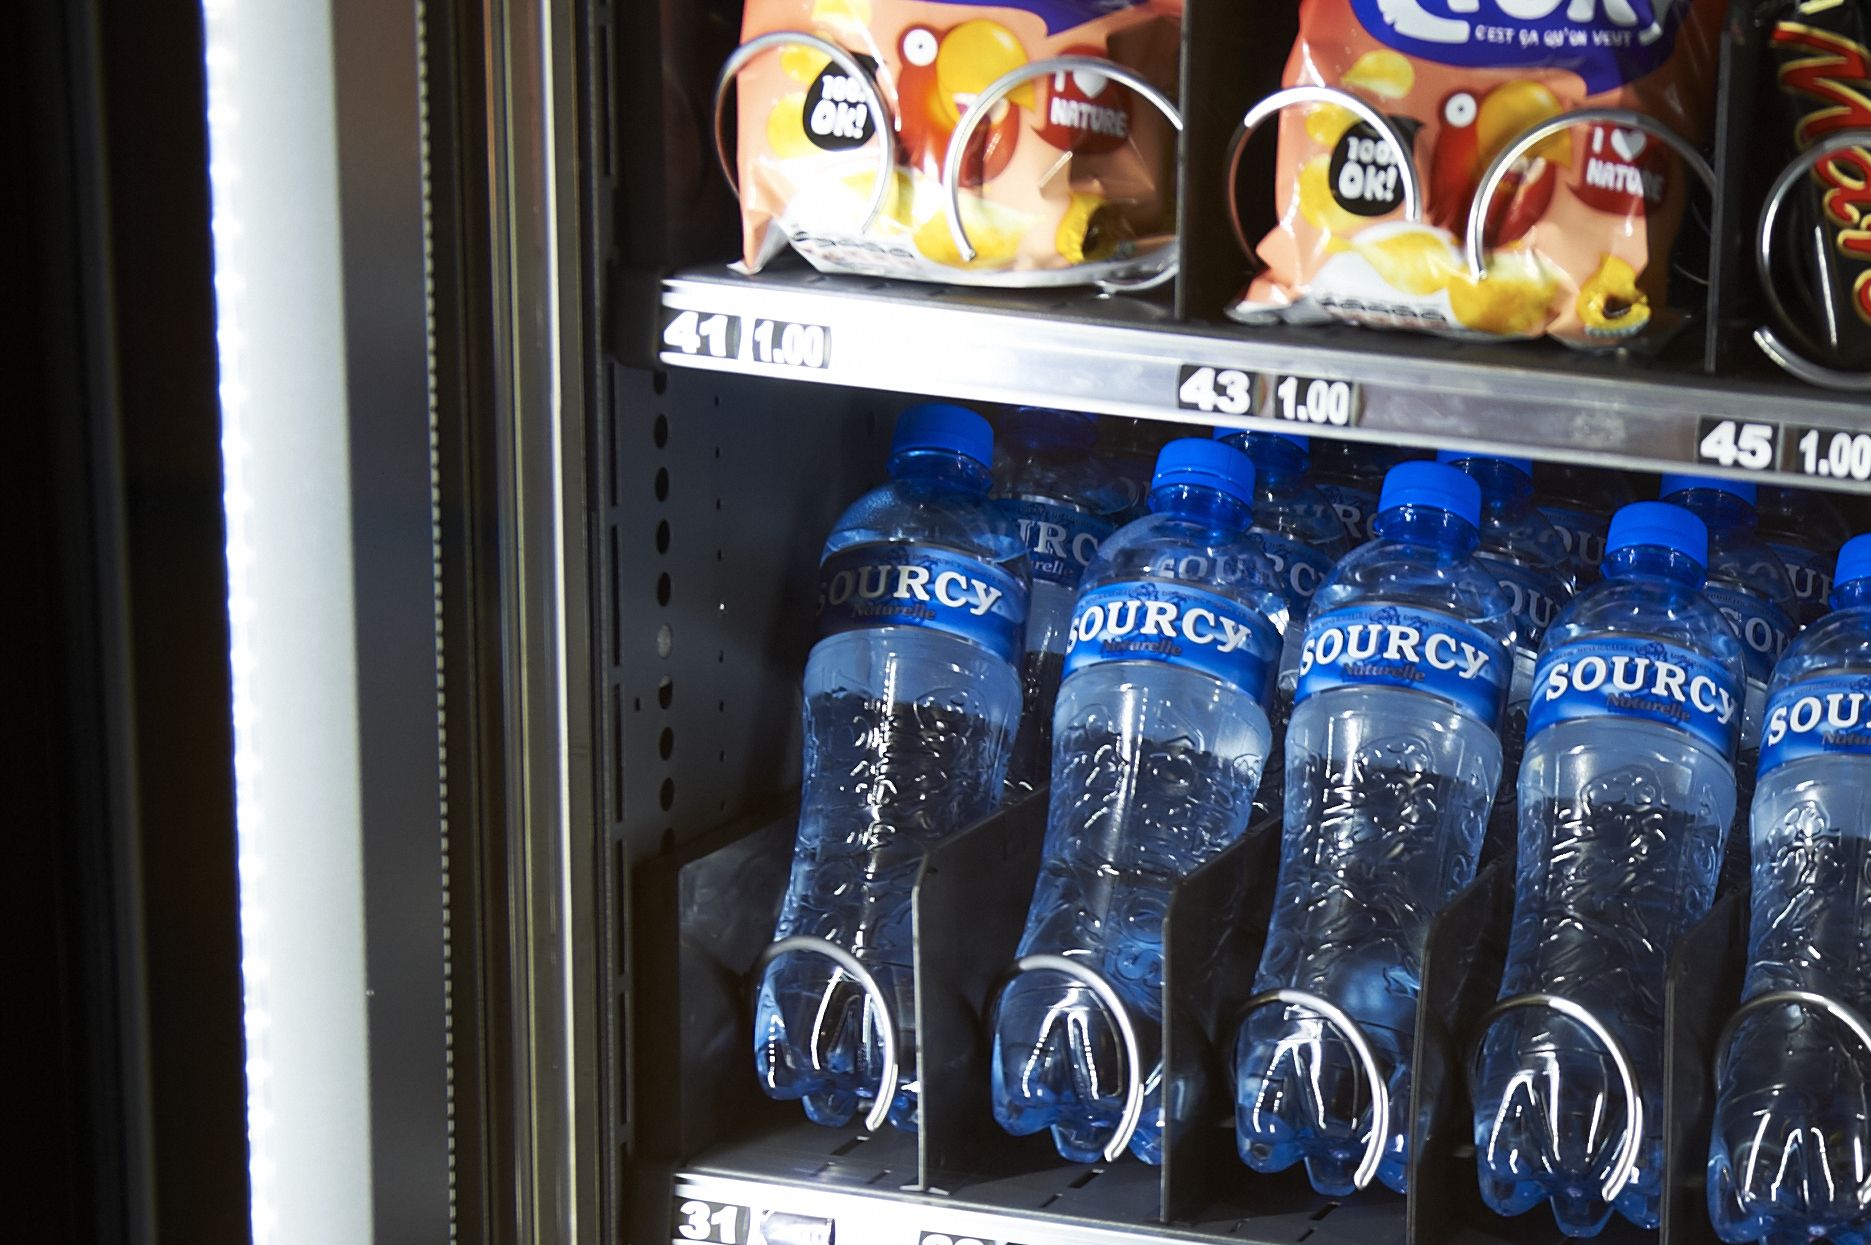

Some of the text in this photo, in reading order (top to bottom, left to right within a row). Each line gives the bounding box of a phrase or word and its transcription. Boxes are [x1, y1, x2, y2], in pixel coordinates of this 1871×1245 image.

[810, 101, 868, 139] OK!
[1050, 96, 1127, 134] NATURE
[1338, 164, 1398, 202] OK!
[1585, 157, 1665, 200] NATURE
[664, 311, 824, 367] 41 1.00
[1179, 366, 1350, 425] 43 1.00
[1700, 420, 1773, 470] 45
[1066, 600, 1253, 654] SOURCY
[1300, 623, 1490, 680] SOURCY
[1545, 655, 1737, 725] SOURCY
[678, 1200, 739, 1245] 31
